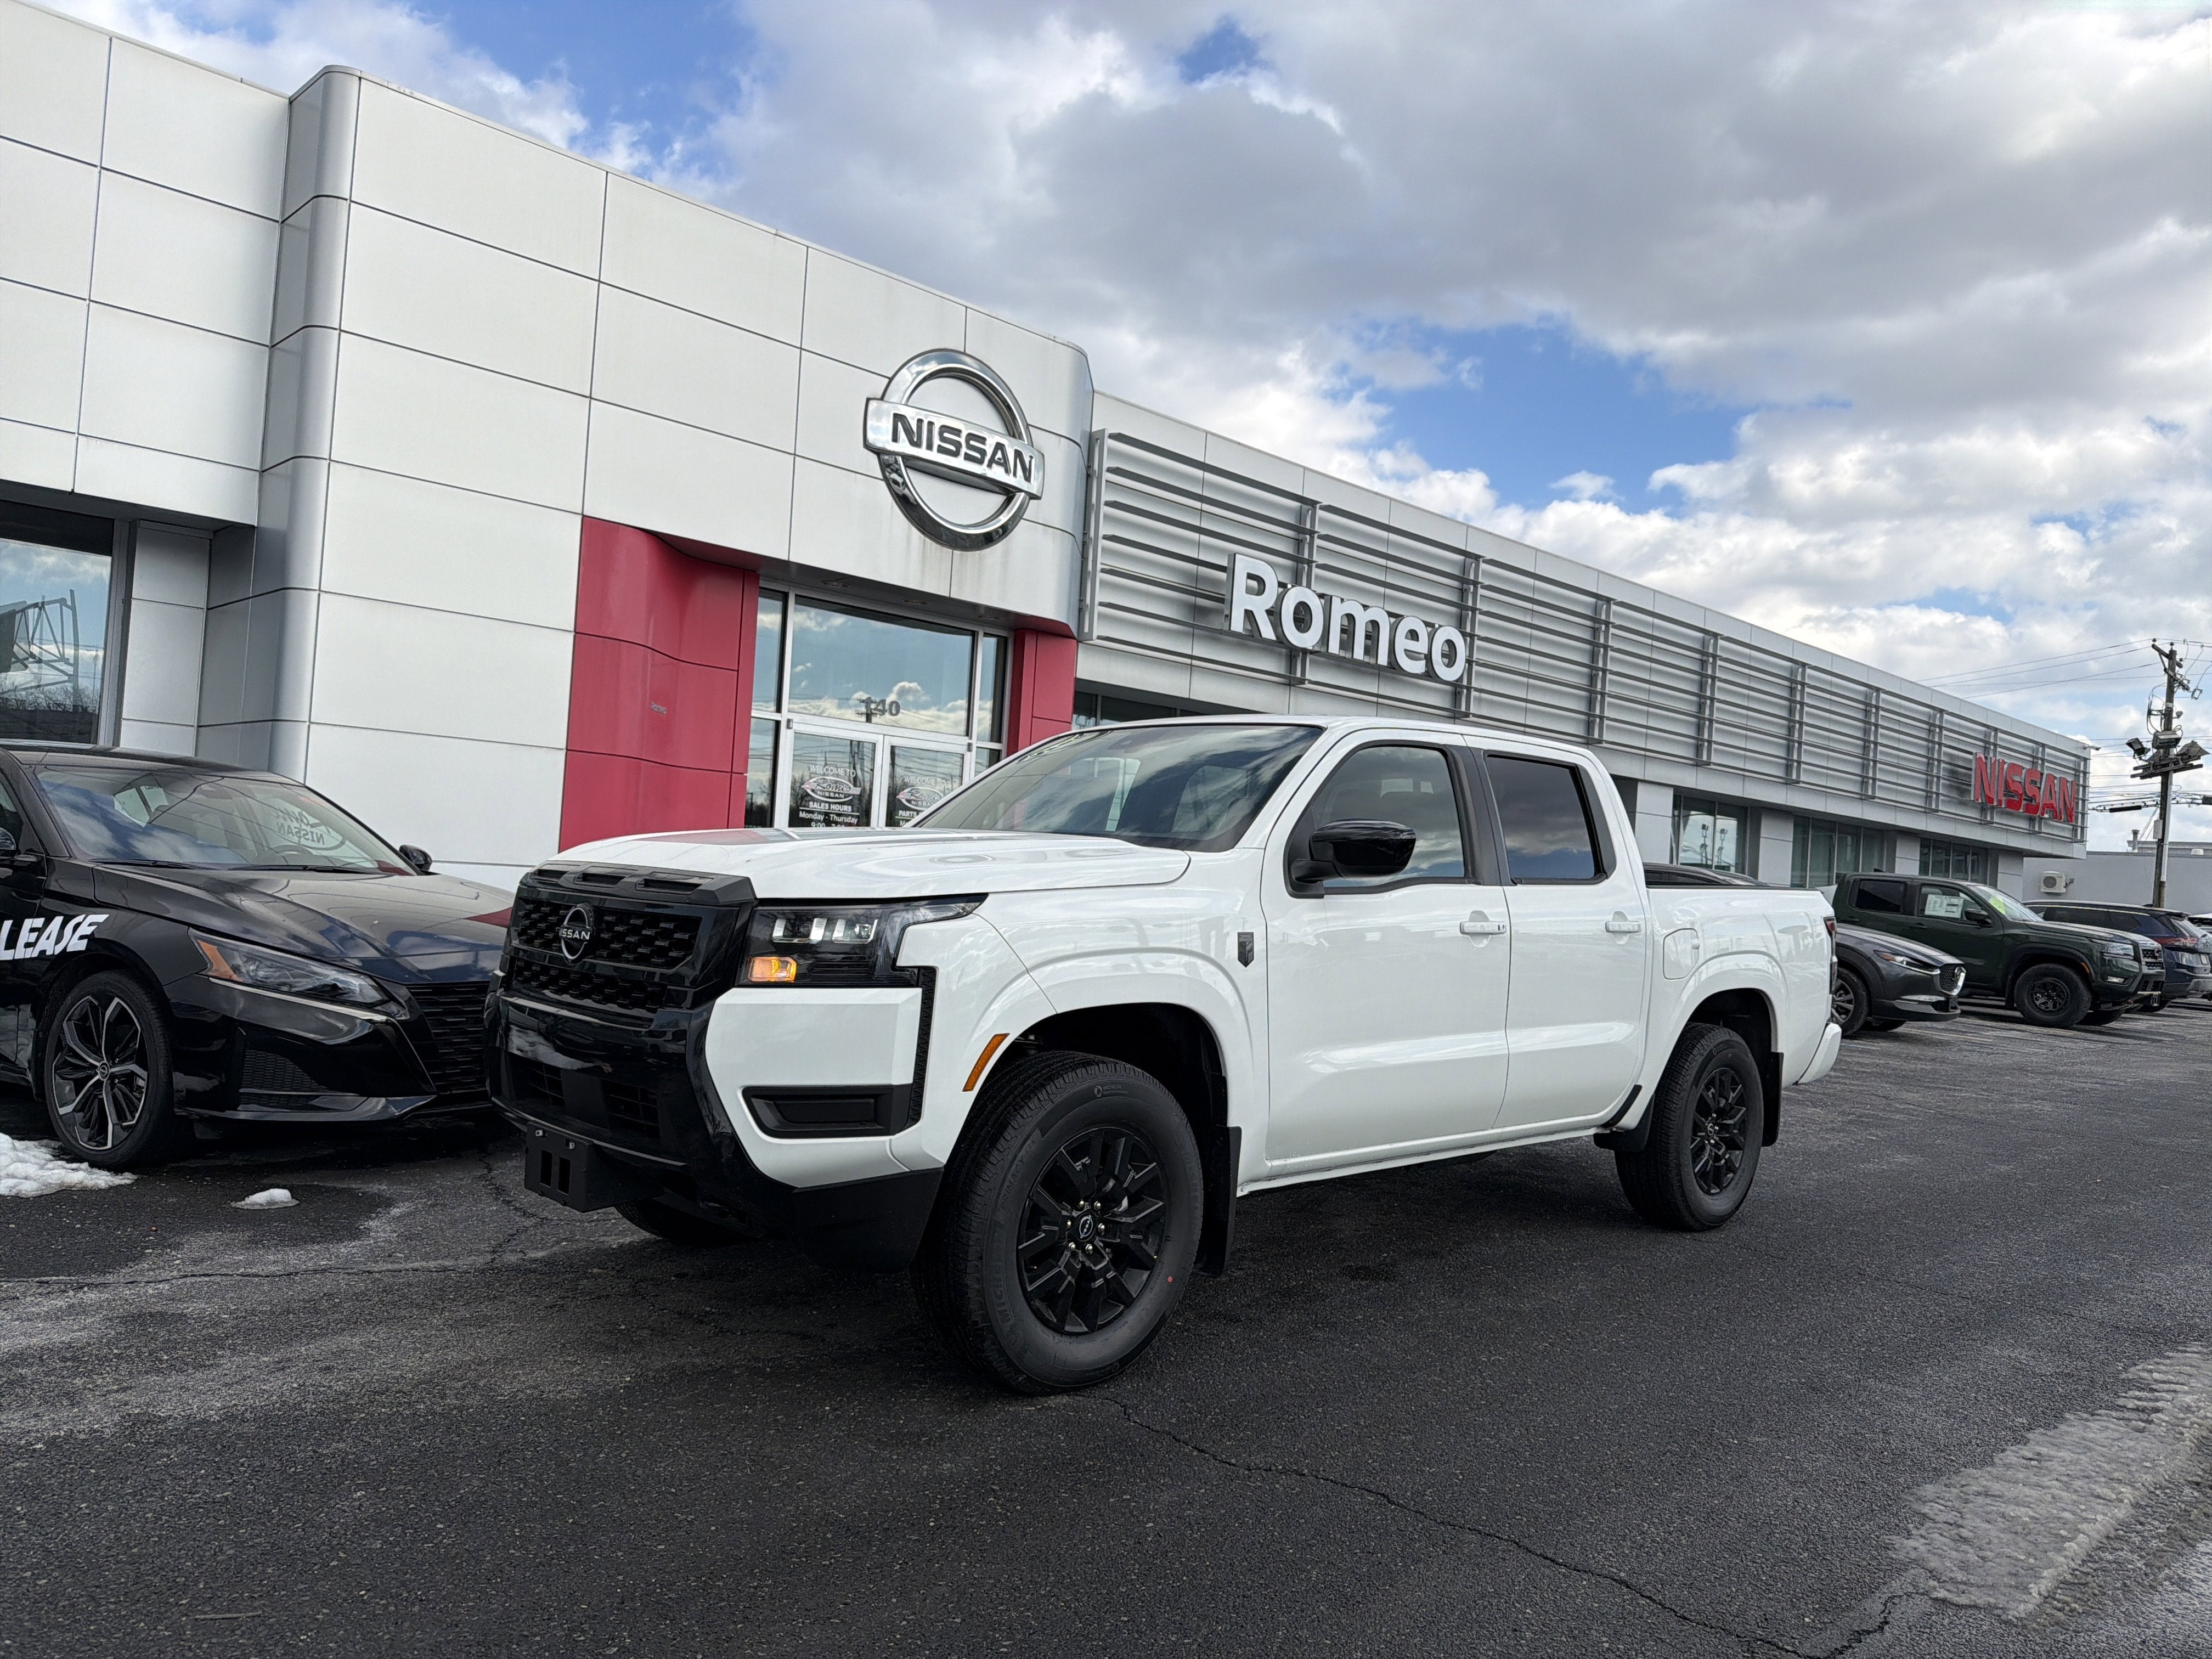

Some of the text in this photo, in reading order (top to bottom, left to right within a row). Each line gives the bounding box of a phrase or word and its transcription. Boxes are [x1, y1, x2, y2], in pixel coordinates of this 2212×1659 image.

[890, 412, 1035, 484] NISSAN
[1225, 552, 1466, 682] Romeo
[809, 764, 856, 777] WELCOME TO
[814, 777, 851, 793] Romeo
[1973, 752, 2076, 823] NISSAN
[799, 811, 825, 822] Monday
[830, 814, 858, 825] Thursday
[809, 801, 852, 812] SALES HOURS
[0, 914, 110, 961] LEASE
